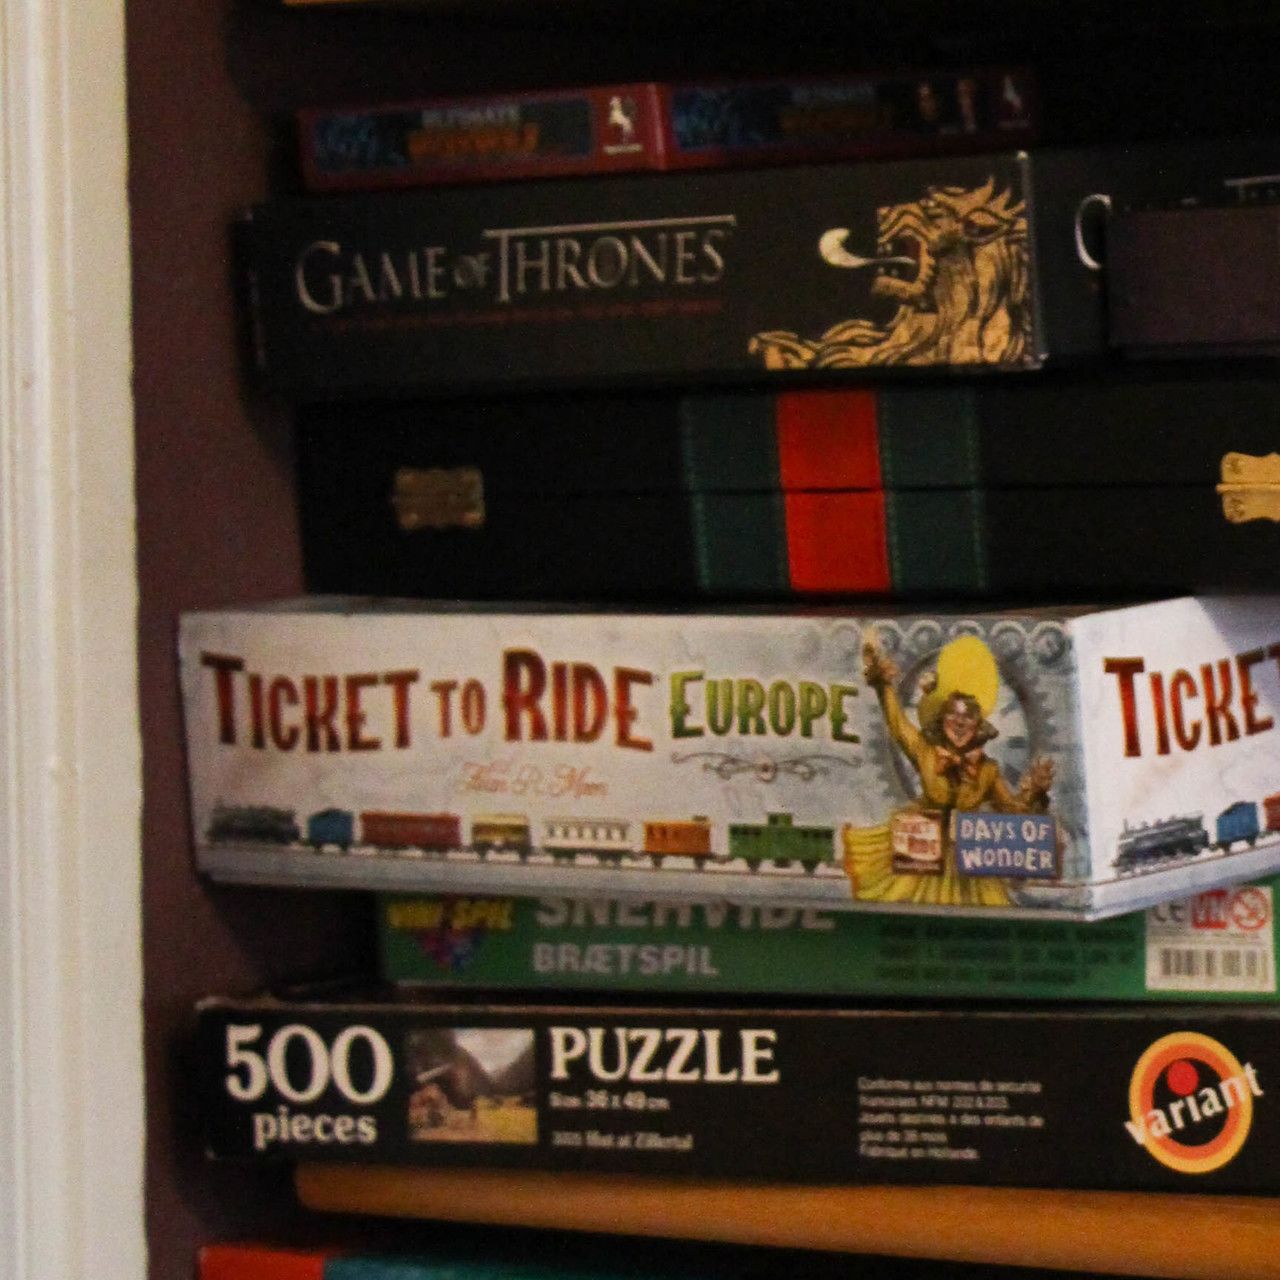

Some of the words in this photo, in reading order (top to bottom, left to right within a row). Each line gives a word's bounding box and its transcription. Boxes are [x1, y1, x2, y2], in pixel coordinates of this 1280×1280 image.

[298, 240, 447, 314] GAME
[482, 215, 736, 304] THRONES
[202, 650, 420, 753] TICKET
[431, 677, 486, 739] TO
[502, 646, 654, 752] RIDE
[669, 670, 860, 745] EUROPE
[960, 818, 1016, 843] DAYS
[1022, 819, 1052, 843] OF
[532, 942, 720, 978] BRÆTSPIL
[225, 1023, 395, 1105] 500
[549, 1027, 781, 1084] PUZZLE
[253, 1104, 379, 1150] pieces
[1123, 1060, 1264, 1148] variant
